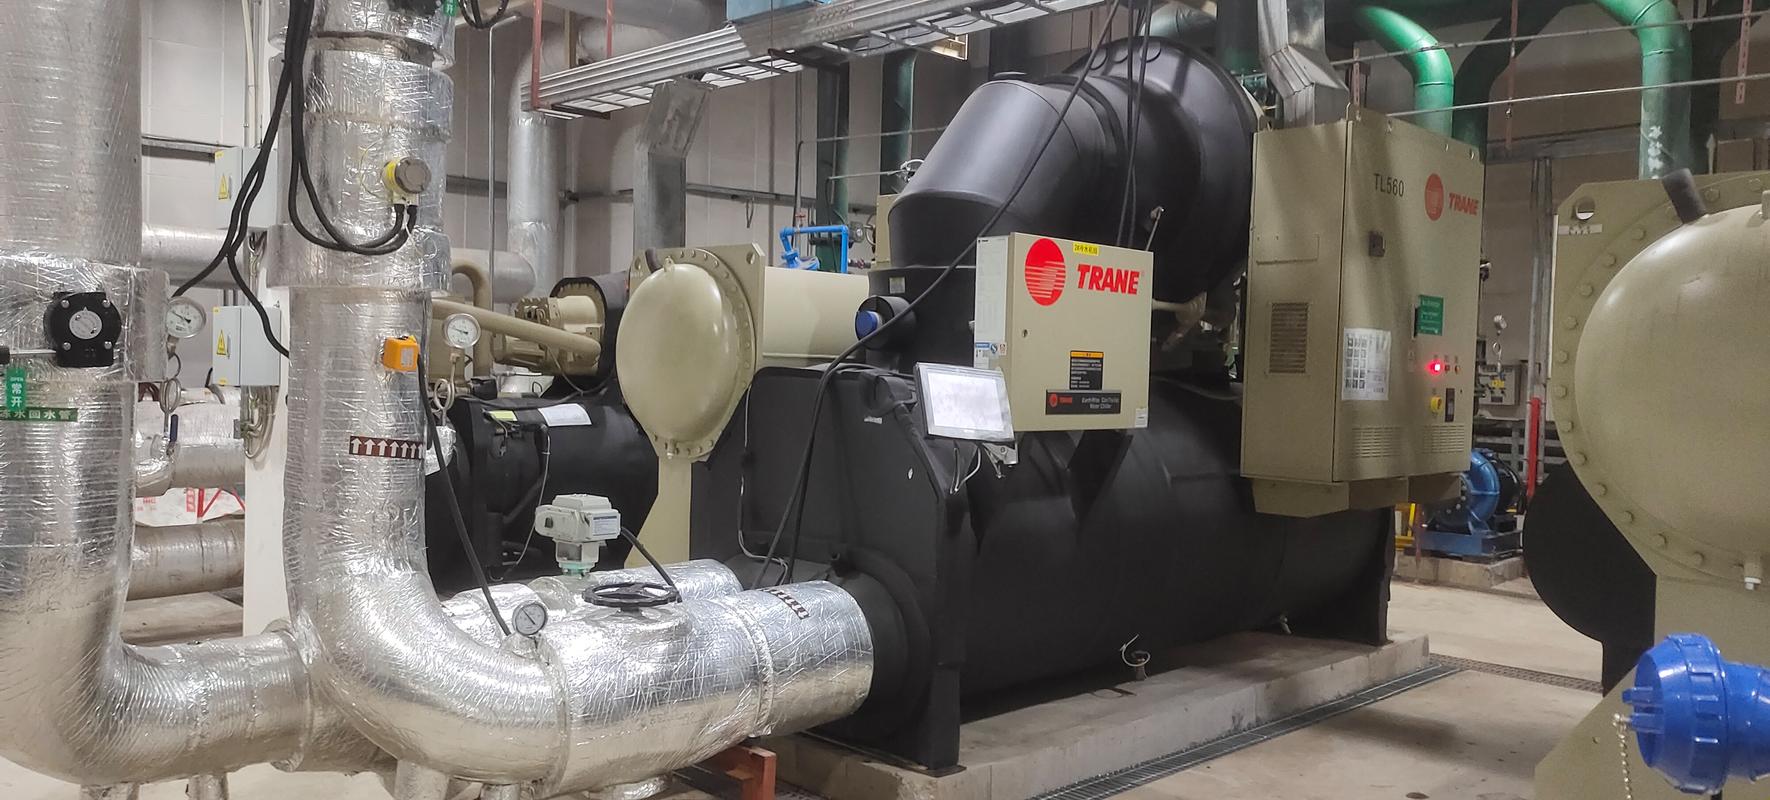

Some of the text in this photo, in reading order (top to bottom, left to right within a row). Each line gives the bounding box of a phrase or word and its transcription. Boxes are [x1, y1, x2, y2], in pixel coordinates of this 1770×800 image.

[1373, 173, 1405, 197] TL560
[1448, 193, 1480, 216] TRANE
[1077, 264, 1140, 295] TRANE
[11, 383, 23, 408] 常开
